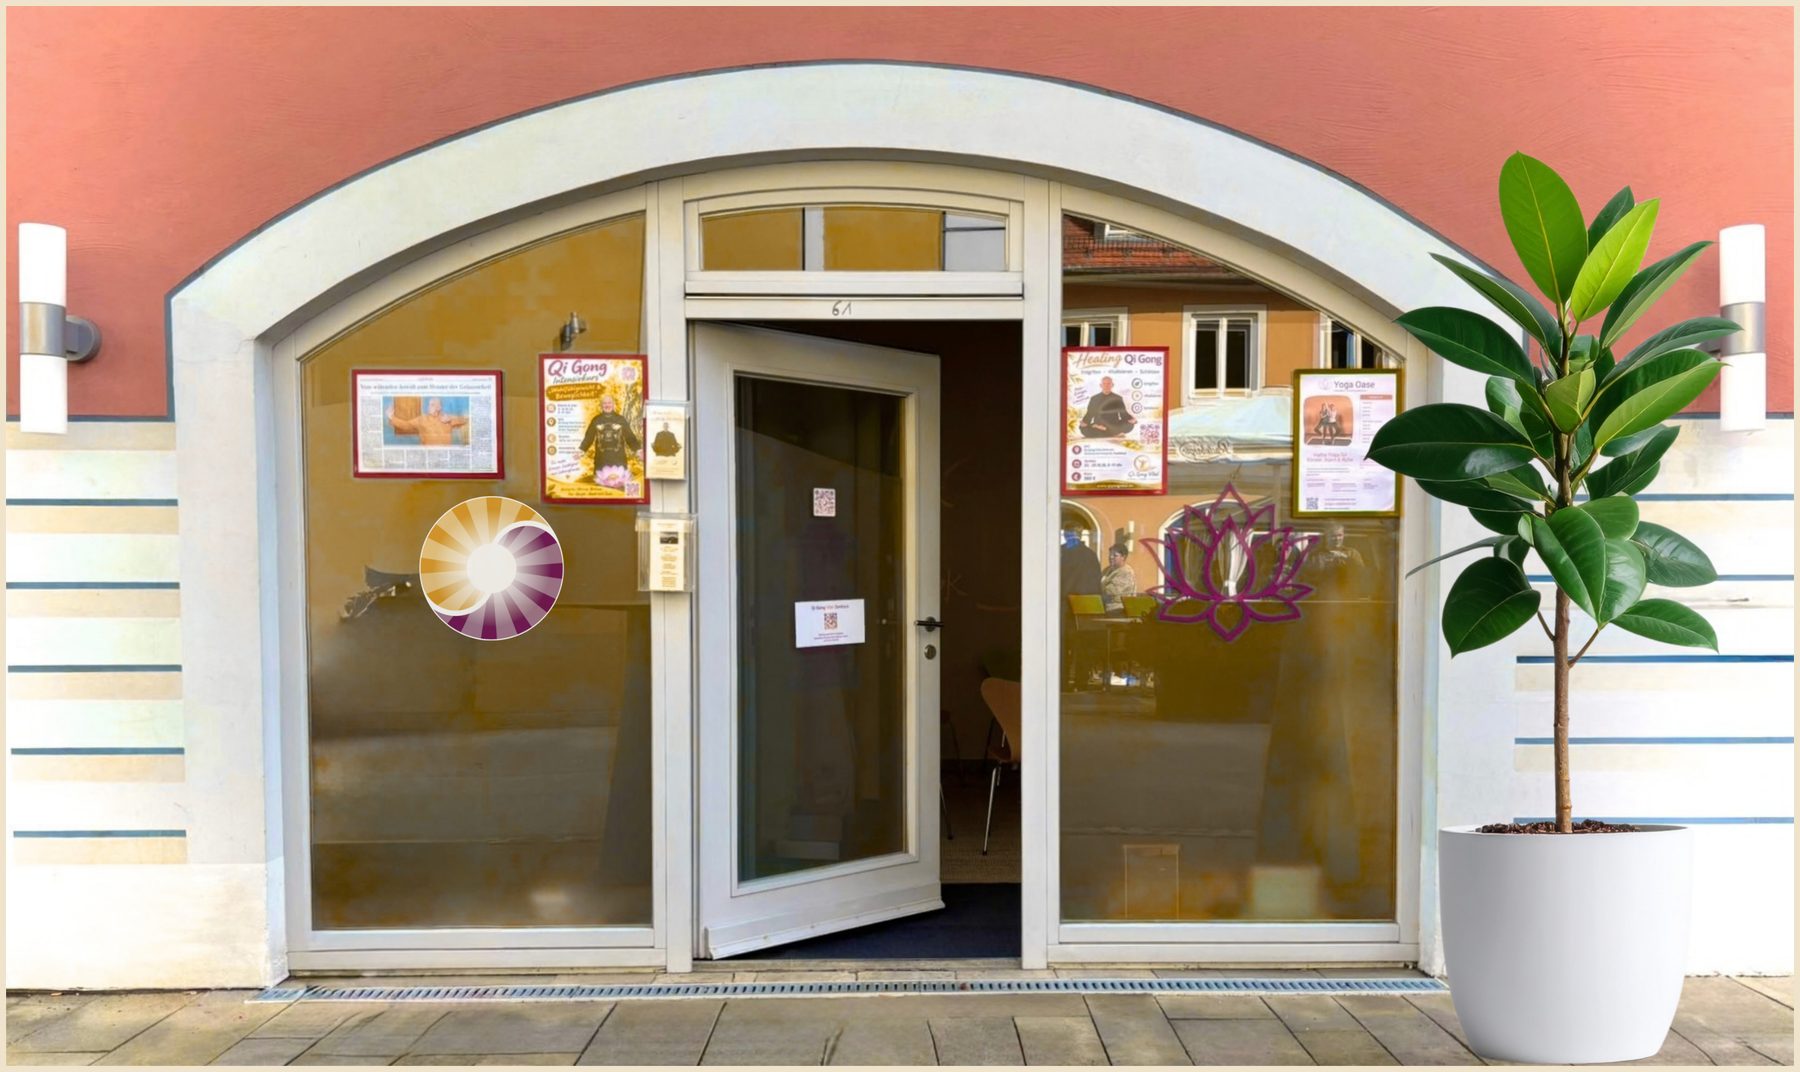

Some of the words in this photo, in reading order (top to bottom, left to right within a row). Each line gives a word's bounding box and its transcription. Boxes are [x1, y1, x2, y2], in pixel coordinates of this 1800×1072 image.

[832, 300, 852, 316] 61
[548, 360, 568, 376] Qi
[571, 359, 608, 376] Gong
[1073, 352, 1121, 368] Healing
[1124, 354, 1137, 365] Qi
[1138, 354, 1163, 366] Gong
[552, 374, 600, 385] Intensivkurs
[1334, 380, 1354, 390] Yoga
[1355, 380, 1376, 389] Oase
